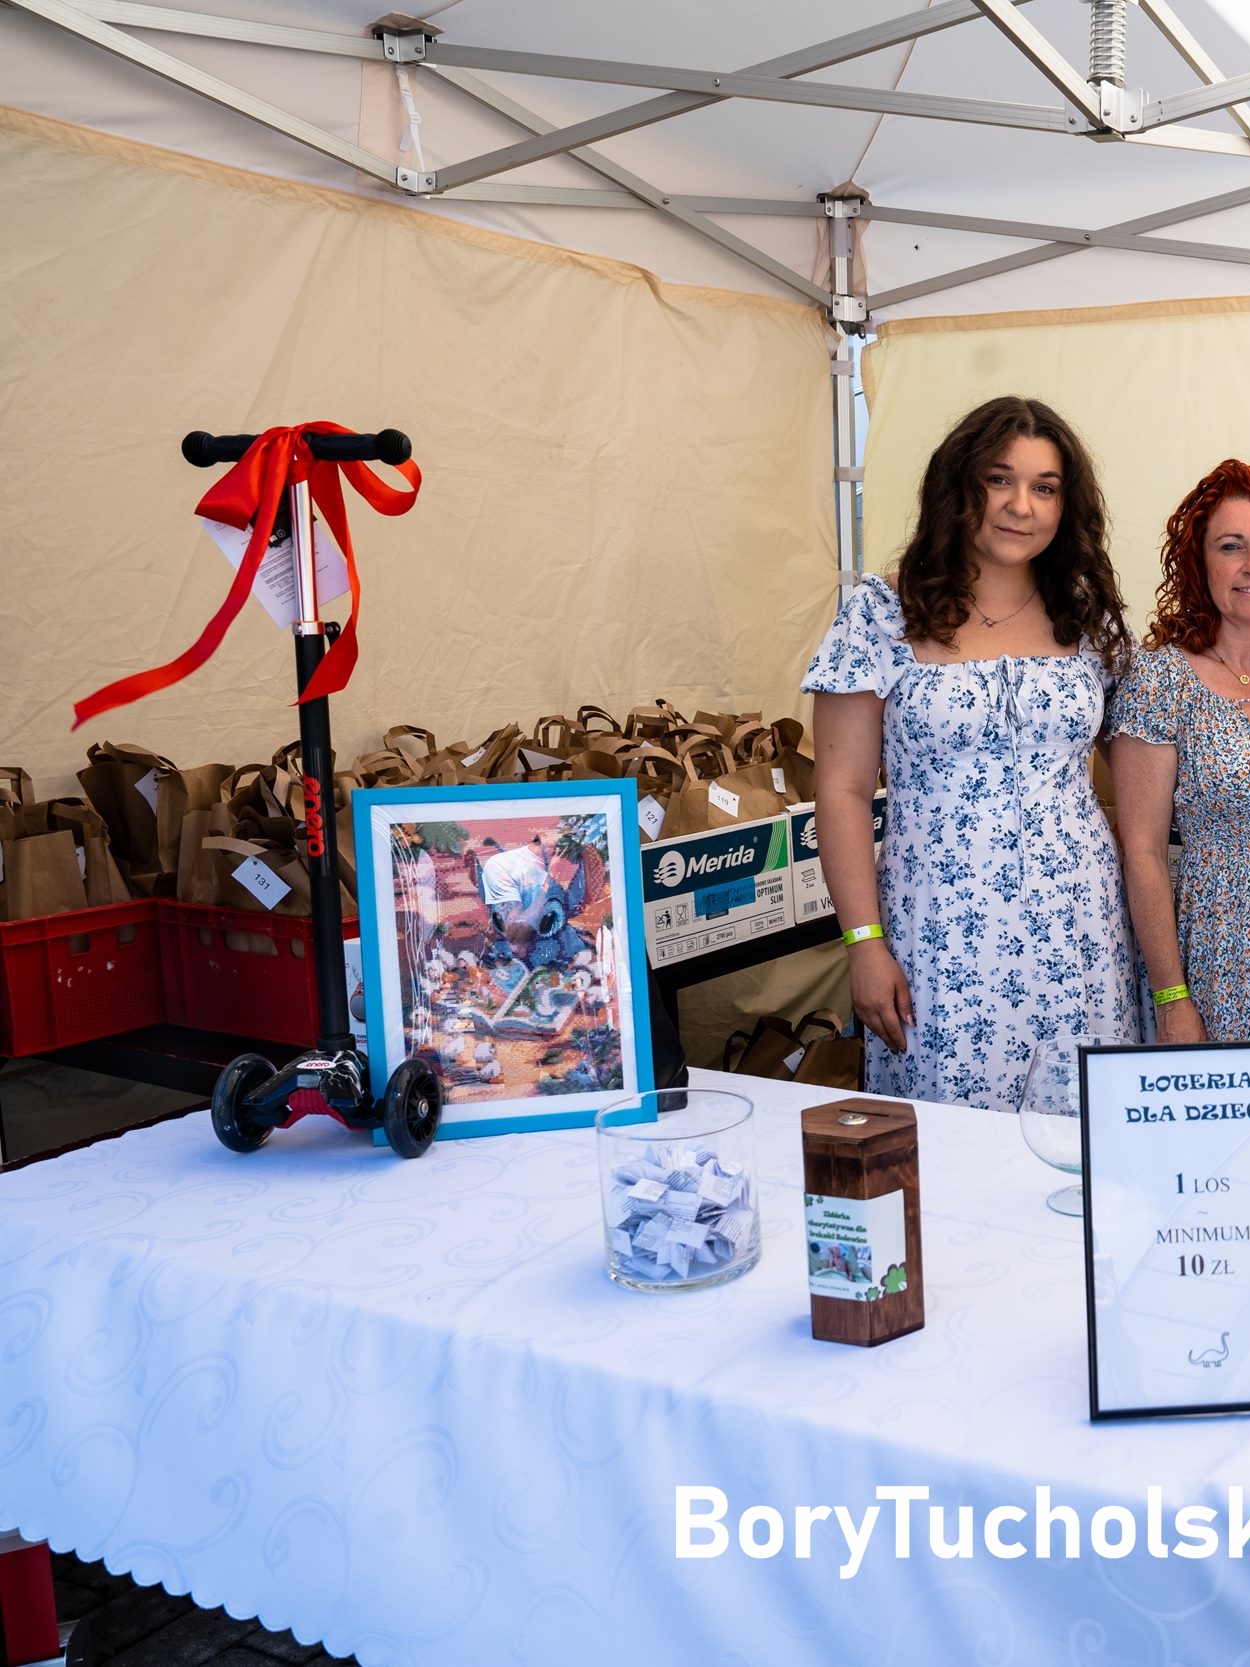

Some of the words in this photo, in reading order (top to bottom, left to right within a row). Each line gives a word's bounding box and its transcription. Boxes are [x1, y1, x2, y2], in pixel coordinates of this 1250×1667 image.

[303, 776, 325, 858] enero
[644, 810, 659, 825] 121
[685, 845, 756, 879] Merida
[254, 873, 270, 890] 131
[756, 883, 784, 898] OPTIMUM
[770, 893, 784, 905] SLIM
[1125, 1104, 1177, 1123] DLA
[1175, 1172, 1185, 1194] 1
[1193, 1177, 1231, 1194] LOS
[1156, 1225, 1250, 1245] MINIMUM
[1178, 1253, 1205, 1277] 10
[1211, 1259, 1235, 1275] ZŁ
